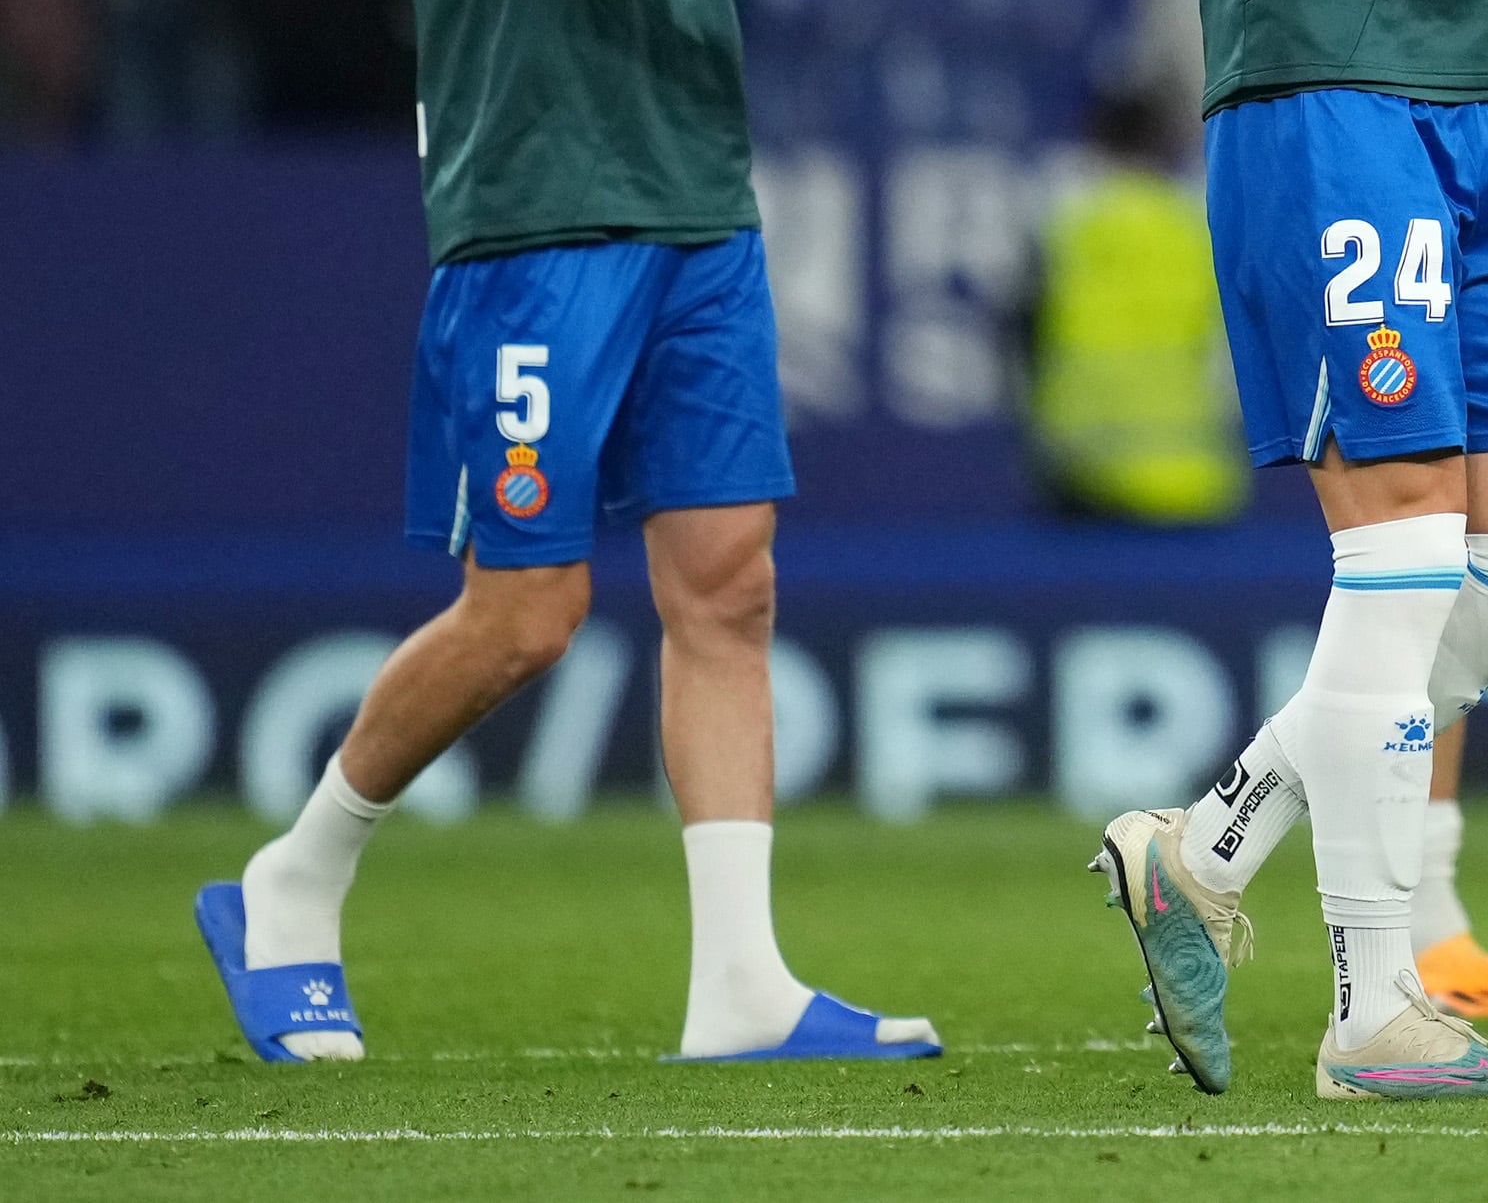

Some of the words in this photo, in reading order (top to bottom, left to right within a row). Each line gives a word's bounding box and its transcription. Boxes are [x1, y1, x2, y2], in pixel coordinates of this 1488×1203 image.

[1321, 219, 1452, 327] 24
[1373, 350, 1414, 371] ESPANYOL
[496, 344, 549, 443] 5
[1371, 377, 1415, 403] BARCELONA
[290, 1009, 350, 1022] KELME
